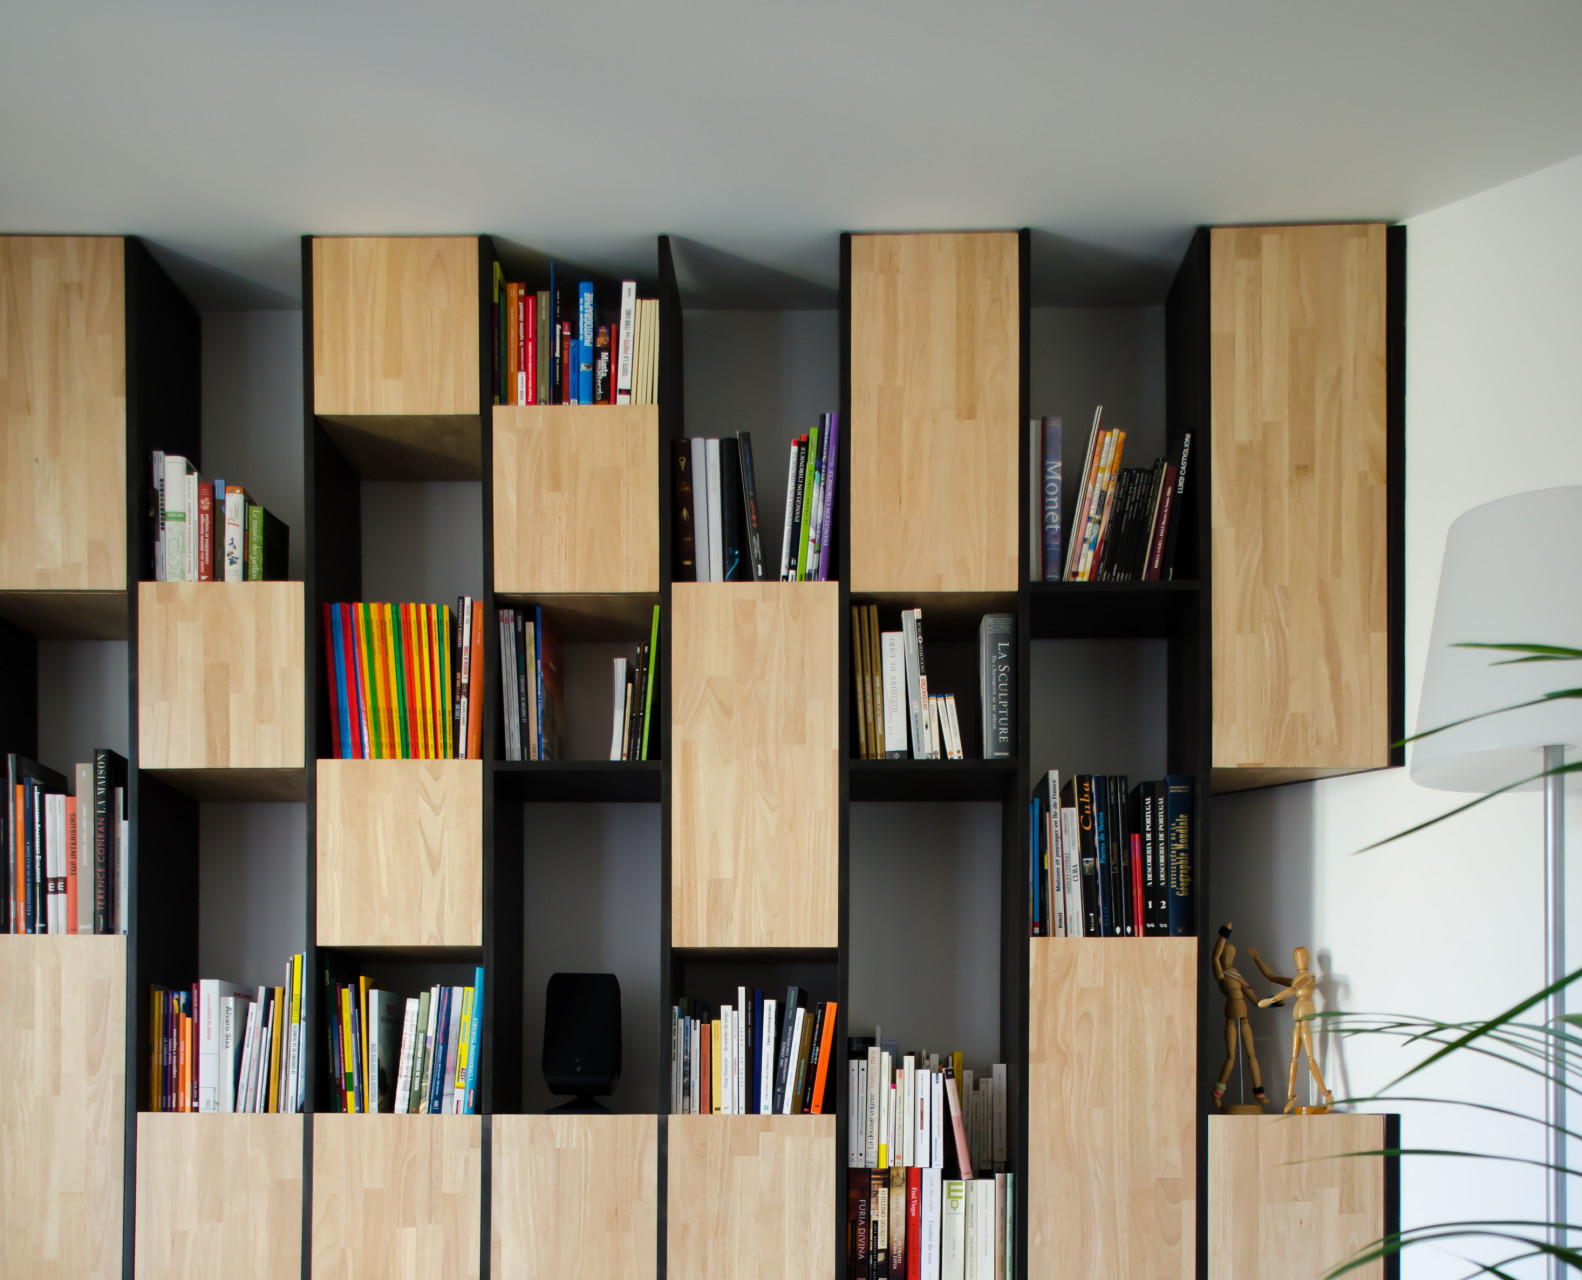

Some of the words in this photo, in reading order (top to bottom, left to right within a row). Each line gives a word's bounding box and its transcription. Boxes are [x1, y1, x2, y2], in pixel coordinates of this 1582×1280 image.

[584, 292, 593, 346] PHOTOGRAPHIE
[798, 446, 806, 483] CHRONICLE
[1179, 434, 1191, 475] CASTIGLIONI
[825, 470, 834, 506] CHRONICLE
[1177, 476, 1185, 494] LUIGI
[795, 484, 804, 522] EVANGELION
[1045, 461, 1062, 532] Monet
[252, 510, 260, 518] Le
[252, 544, 260, 555] des
[251, 556, 260, 580] jardins
[998, 643, 1009, 659] LA
[891, 661, 896, 671] DE
[998, 665, 1010, 743] SCULPTURE
[97, 754, 105, 795] MAISON
[97, 800, 105, 813] LA
[1080, 782, 1092, 830] Cuba
[1098, 833, 1105, 841] de
[1146, 832, 1152, 840] DE
[1159, 832, 1165, 840] DE
[1175, 814, 1189, 849] Mondiale
[1175, 852, 1191, 896] Géographie
[1147, 900, 1152, 909] 1
[1160, 900, 1166, 909] 2
[909, 1200, 917, 1216] Vargas
